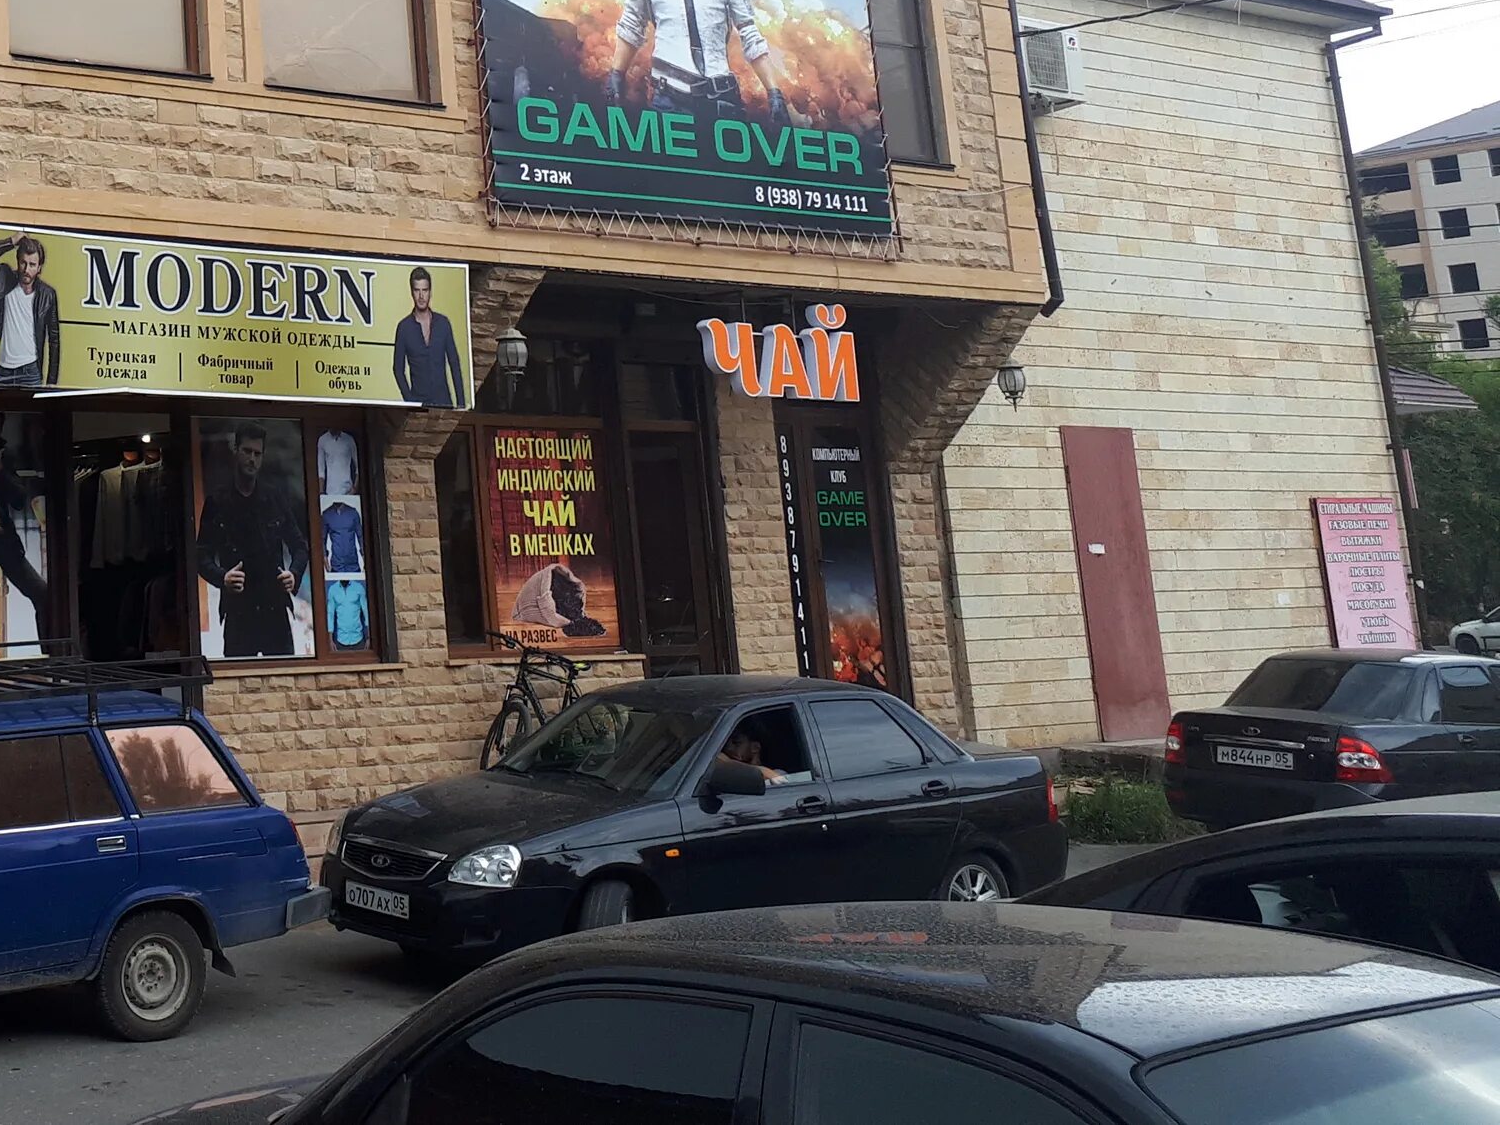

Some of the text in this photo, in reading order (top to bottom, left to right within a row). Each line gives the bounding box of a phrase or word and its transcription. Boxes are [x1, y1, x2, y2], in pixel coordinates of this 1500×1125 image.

[516, 96, 864, 175] GAME OVER
[520, 164, 573, 186] 2 этаж
[755, 186, 868, 213] 8 (938) 79 14 111
[82, 245, 377, 326] MODERN
[112, 320, 356, 350] МАГАЗИН МУЖСКОЙ ОДЕЖДЫ
[86, 347, 156, 366] Турецкая
[697, 303, 860, 402] ЧАЙ
[196, 352, 274, 374] Фабричный
[314, 361, 371, 378] Одежда и
[96, 365, 148, 381] одежда
[218, 371, 254, 388] товар
[328, 376, 362, 393] обувь
[494, 434, 593, 462] НАСТОЯЩИЙ
[497, 468, 595, 493] ИНДИЙСКИЙ
[829, 470, 847, 483] КЛУБ
[816, 490, 865, 506] GAME
[523, 494, 577, 528] ЧАЙ
[1320, 503, 1393, 514] СТИРАЛЬНЫЕ МАШИНЫ
[819, 511, 868, 527] OVER
[1328, 520, 1389, 530] ГАЗОВЫЕ ПЕЧИ
[509, 534, 595, 556] В МЕШКАХ
[1341, 536, 1382, 546] ВЫТЯЖКИ
[1327, 552, 1400, 562] ВАРОЧНЫЕ ПЛИТЫ
[1349, 567, 1385, 576] ЛЮСТРЫ
[1352, 582, 1385, 593] ПОСУДА
[1347, 599, 1396, 610] МЯСОРУБКИ
[1361, 617, 1389, 627] УТЮГИ
[520, 628, 558, 643] РАЗВЕС
[1358, 632, 1396, 644] ЧАЙНИКИ
[1274, 751, 1289, 763] 05
[393, 895, 405, 911] 05
